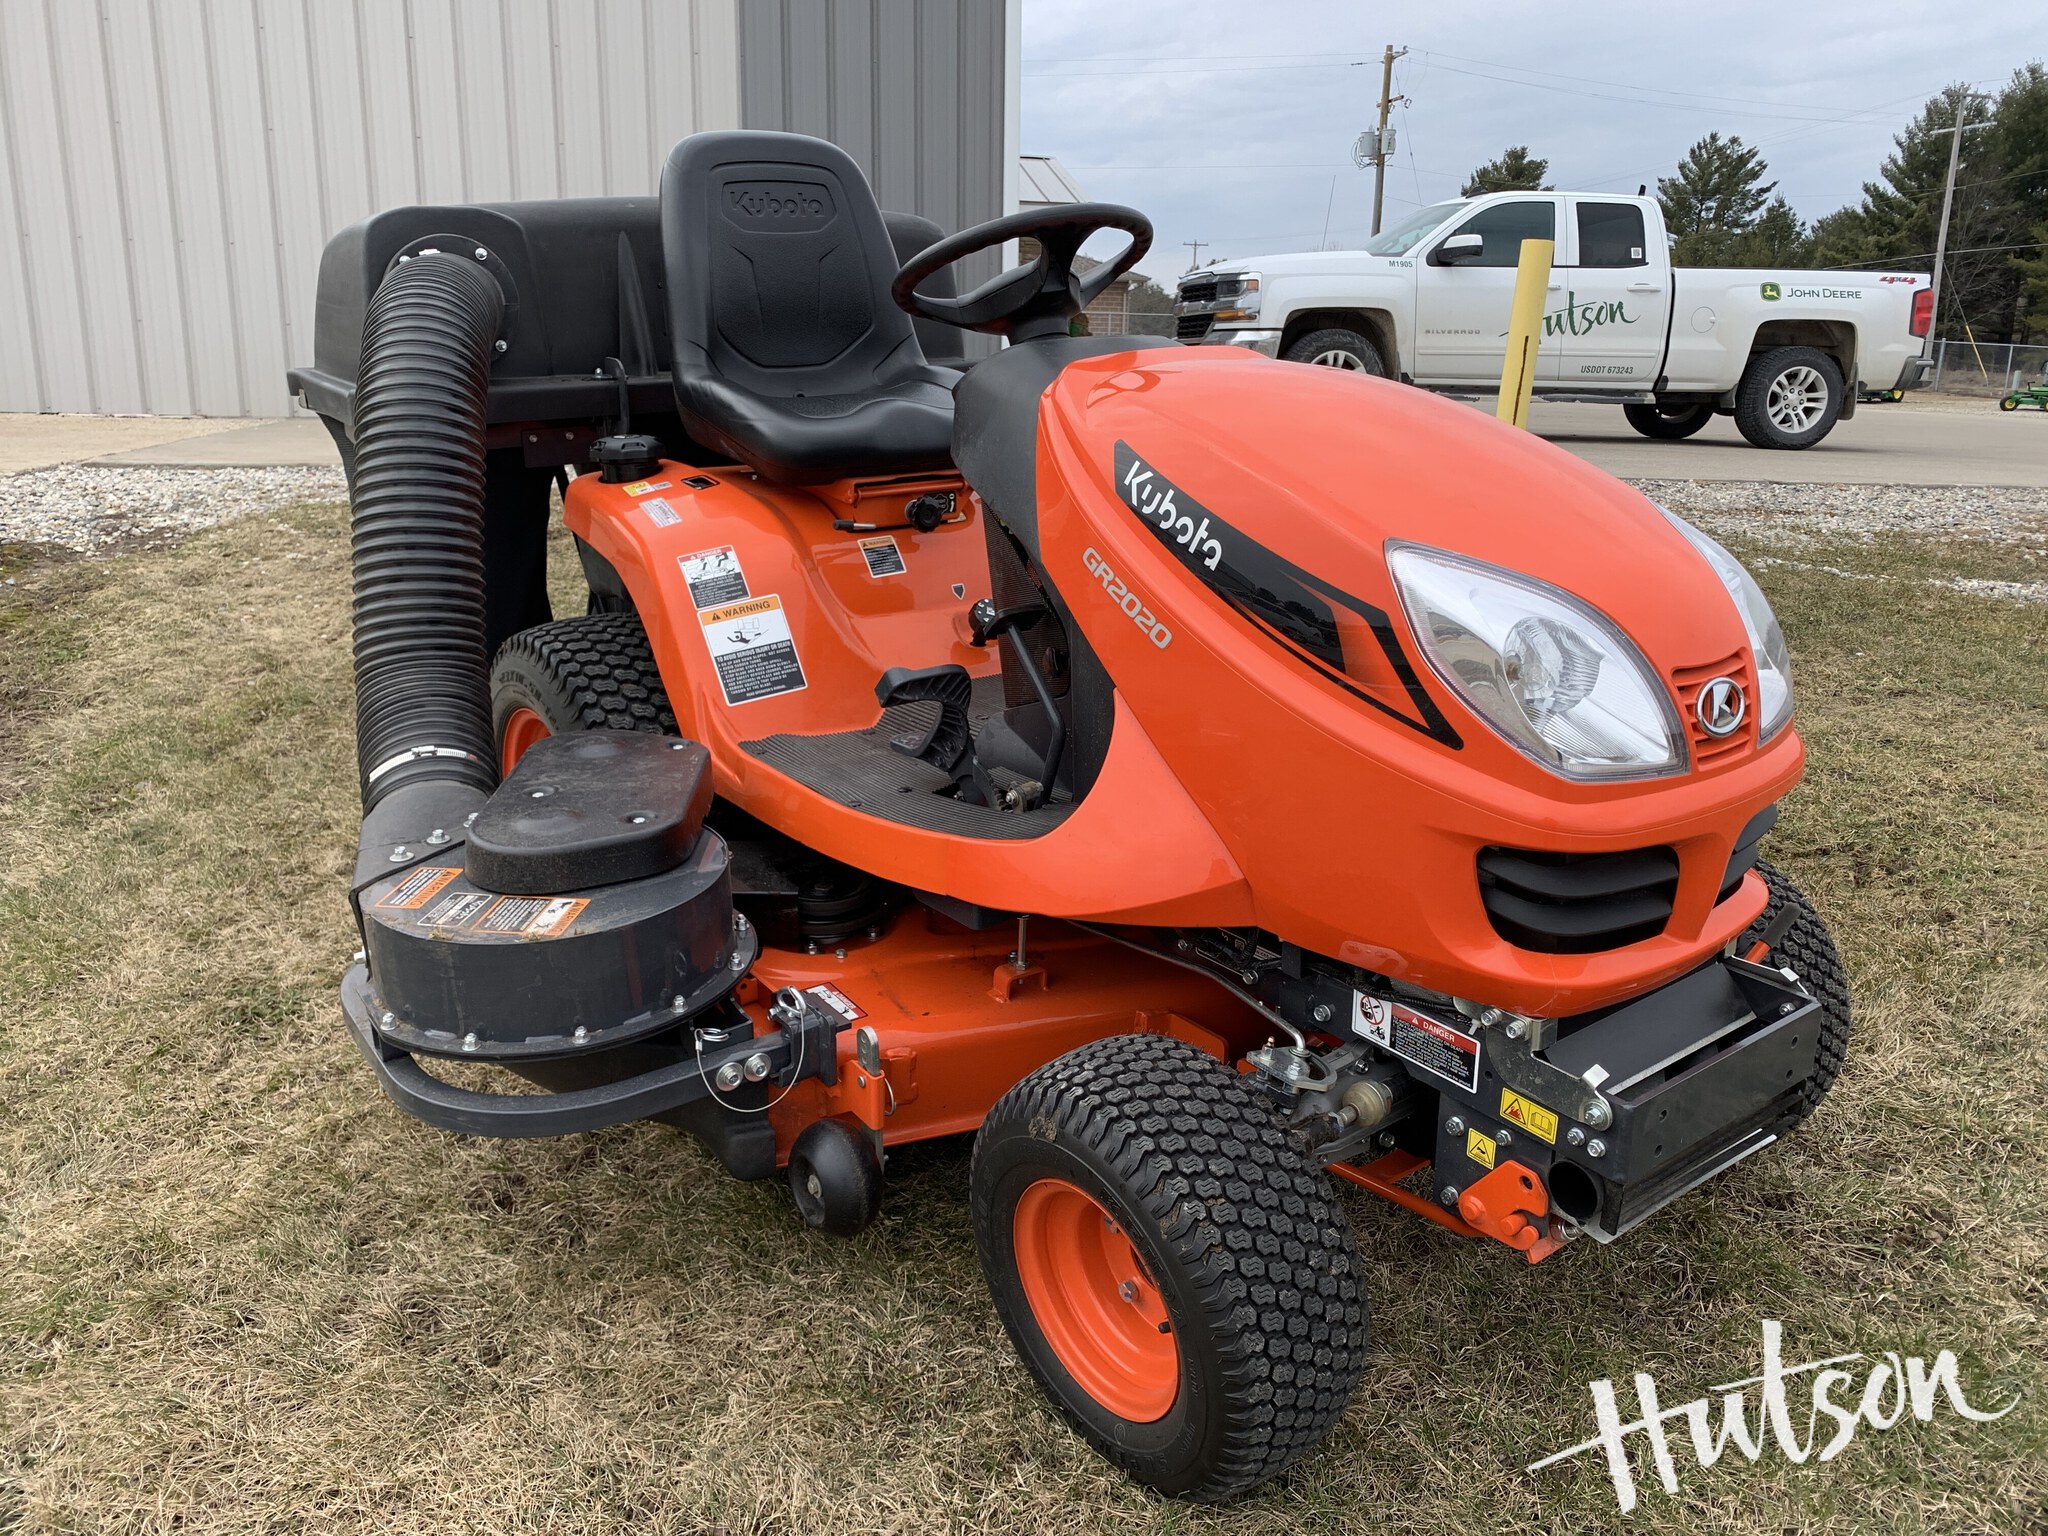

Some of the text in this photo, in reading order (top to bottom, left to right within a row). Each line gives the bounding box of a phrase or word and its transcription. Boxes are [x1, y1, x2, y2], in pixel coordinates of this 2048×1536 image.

[729, 191, 825, 218] Kubota
[1389, 260, 1413, 268] M1905
[1787, 287, 1862, 299] JOHN DEERE
[1581, 365, 1633, 375] USDOT 673243
[1124, 460, 1222, 571] Kubota
[1082, 547, 1172, 649] GR2020
[723, 601, 770, 617] WARNING
[1423, 1021, 1455, 1042] DANGER
